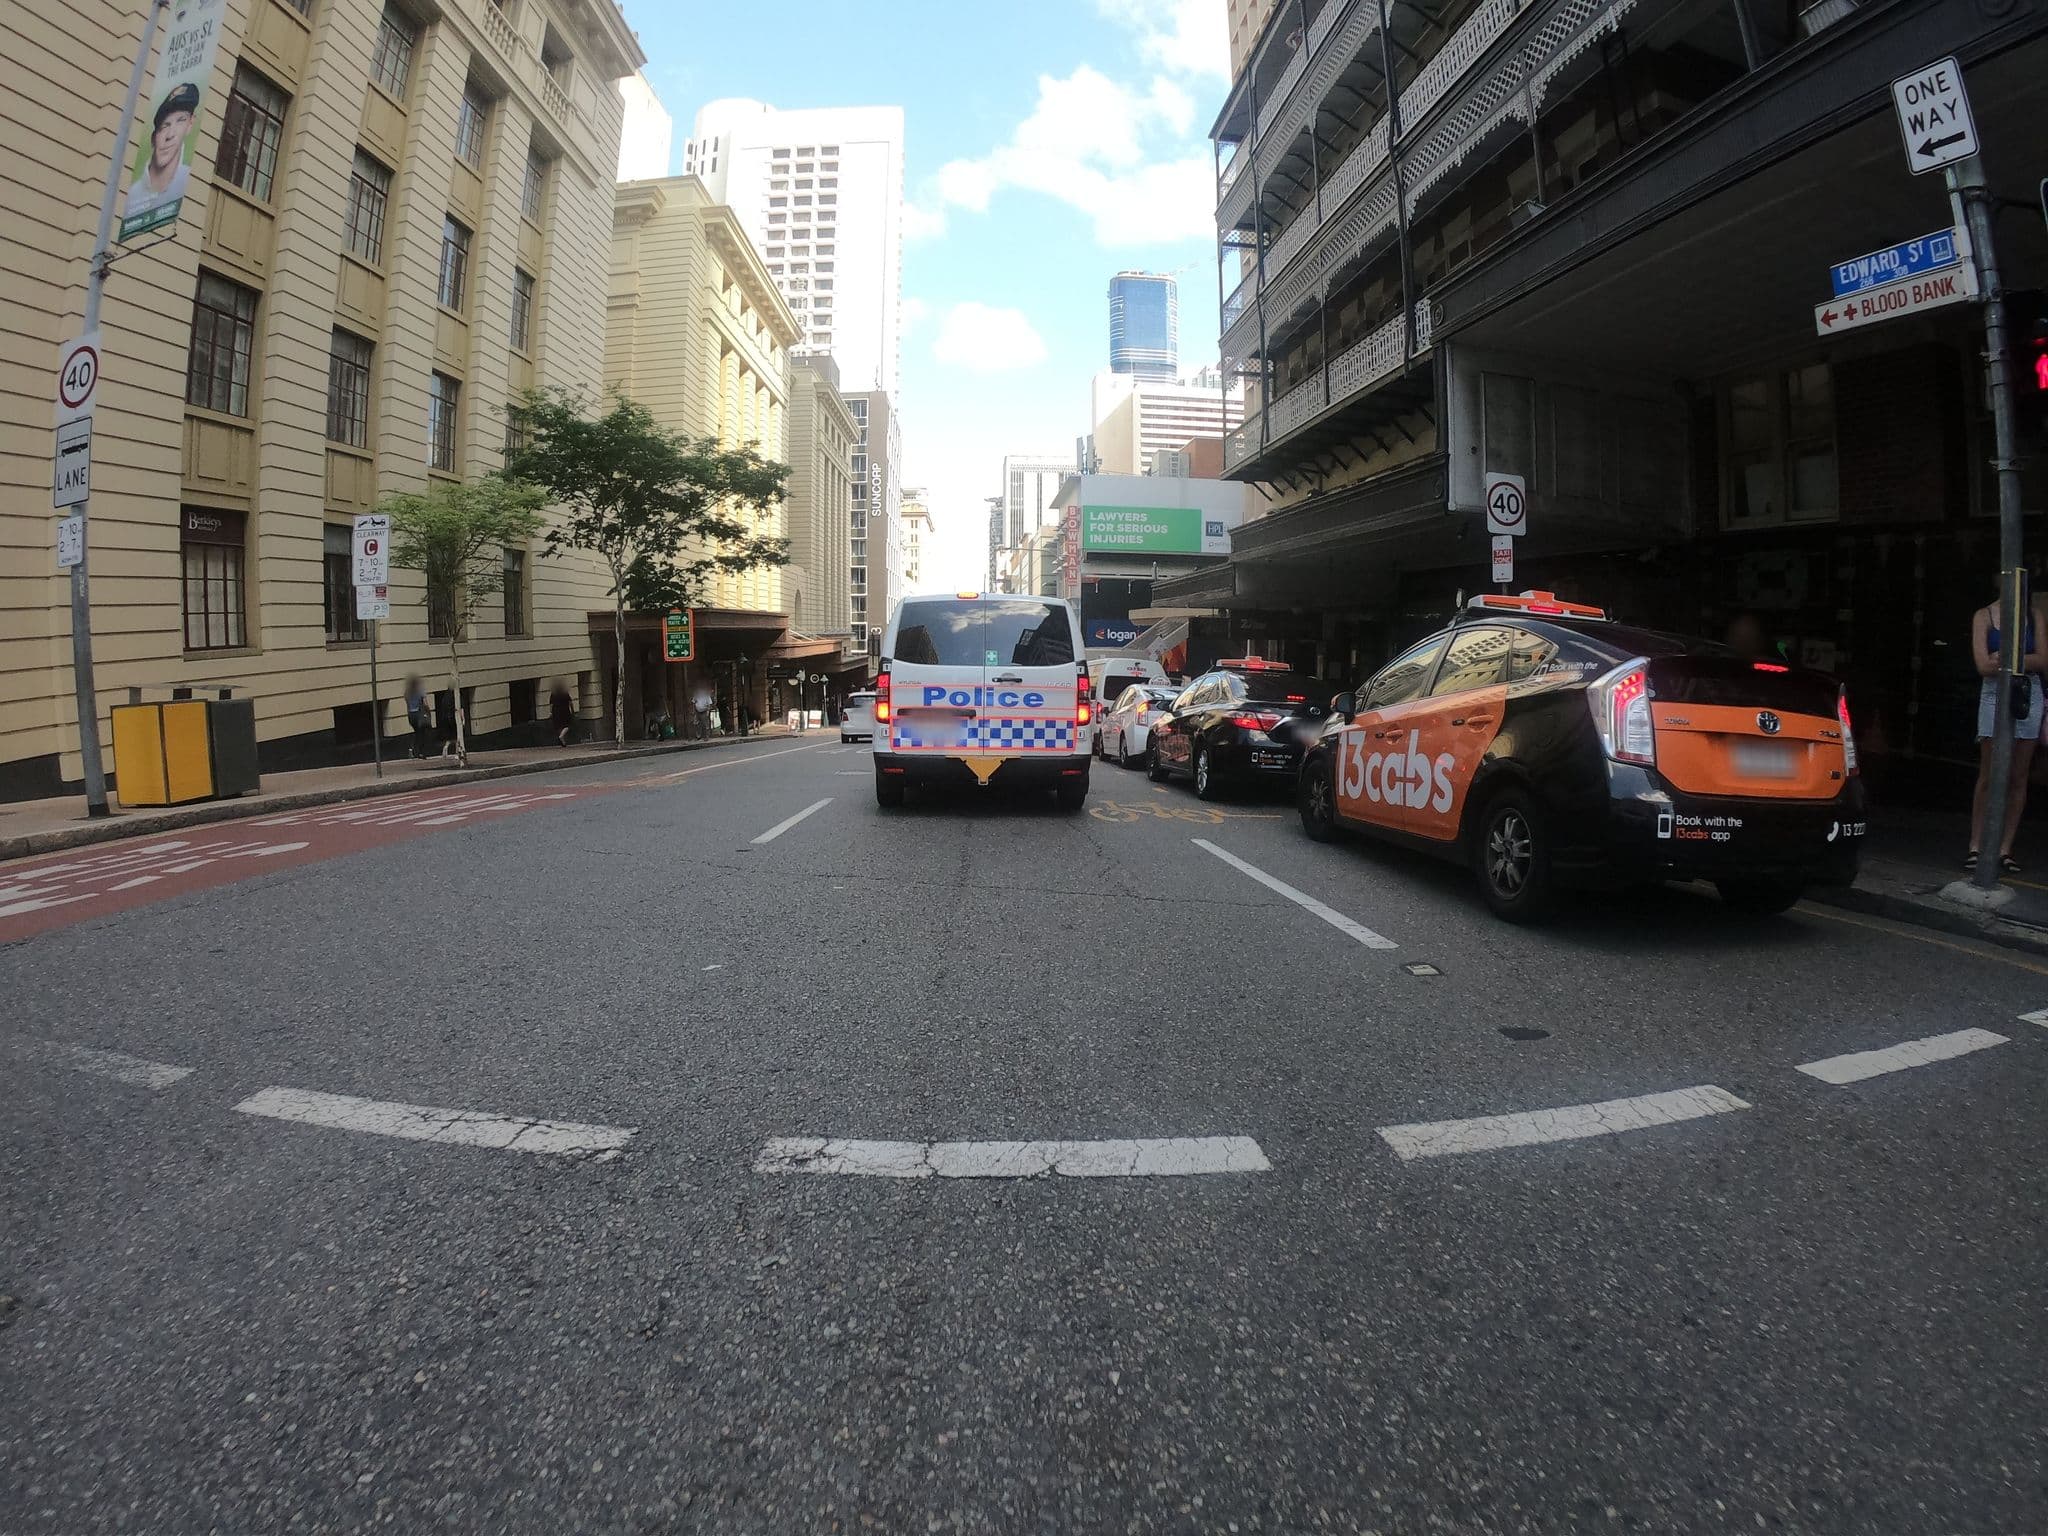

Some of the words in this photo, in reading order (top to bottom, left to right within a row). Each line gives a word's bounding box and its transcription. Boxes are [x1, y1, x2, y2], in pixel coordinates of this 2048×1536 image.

[168, 31, 188, 55] AUS
[201, 19, 213, 38] SL
[1905, 70, 1951, 105] ONE
[1908, 98, 1957, 135] WAY
[1840, 250, 1900, 284] EDWARD
[1908, 241, 1924, 263] ST
[1862, 290, 1908, 317] BLOOD
[1913, 276, 1957, 304] BANK
[66, 362, 90, 390] 40
[57, 466, 87, 491] LANE
[871, 463, 882, 517] SUNCORP
[1492, 493, 1520, 515] 40
[1089, 511, 1148, 522] LAWYERS
[1089, 522, 1114, 532] FOR
[1117, 523, 1168, 534] SERIOUS
[1089, 534, 1144, 544] INJURIES
[1107, 628, 1137, 641] logan
[1584, 662, 1598, 670] the
[923, 686, 1044, 708] Police
[1337, 728, 1456, 814] 13cabs
[1676, 815, 1702, 826] Book
[1704, 817, 1726, 827] with
[1727, 817, 1743, 828] the
[1842, 824, 1851, 836] 13
[1676, 827, 1709, 839] 13cabs
[1711, 831, 1731, 842] app
